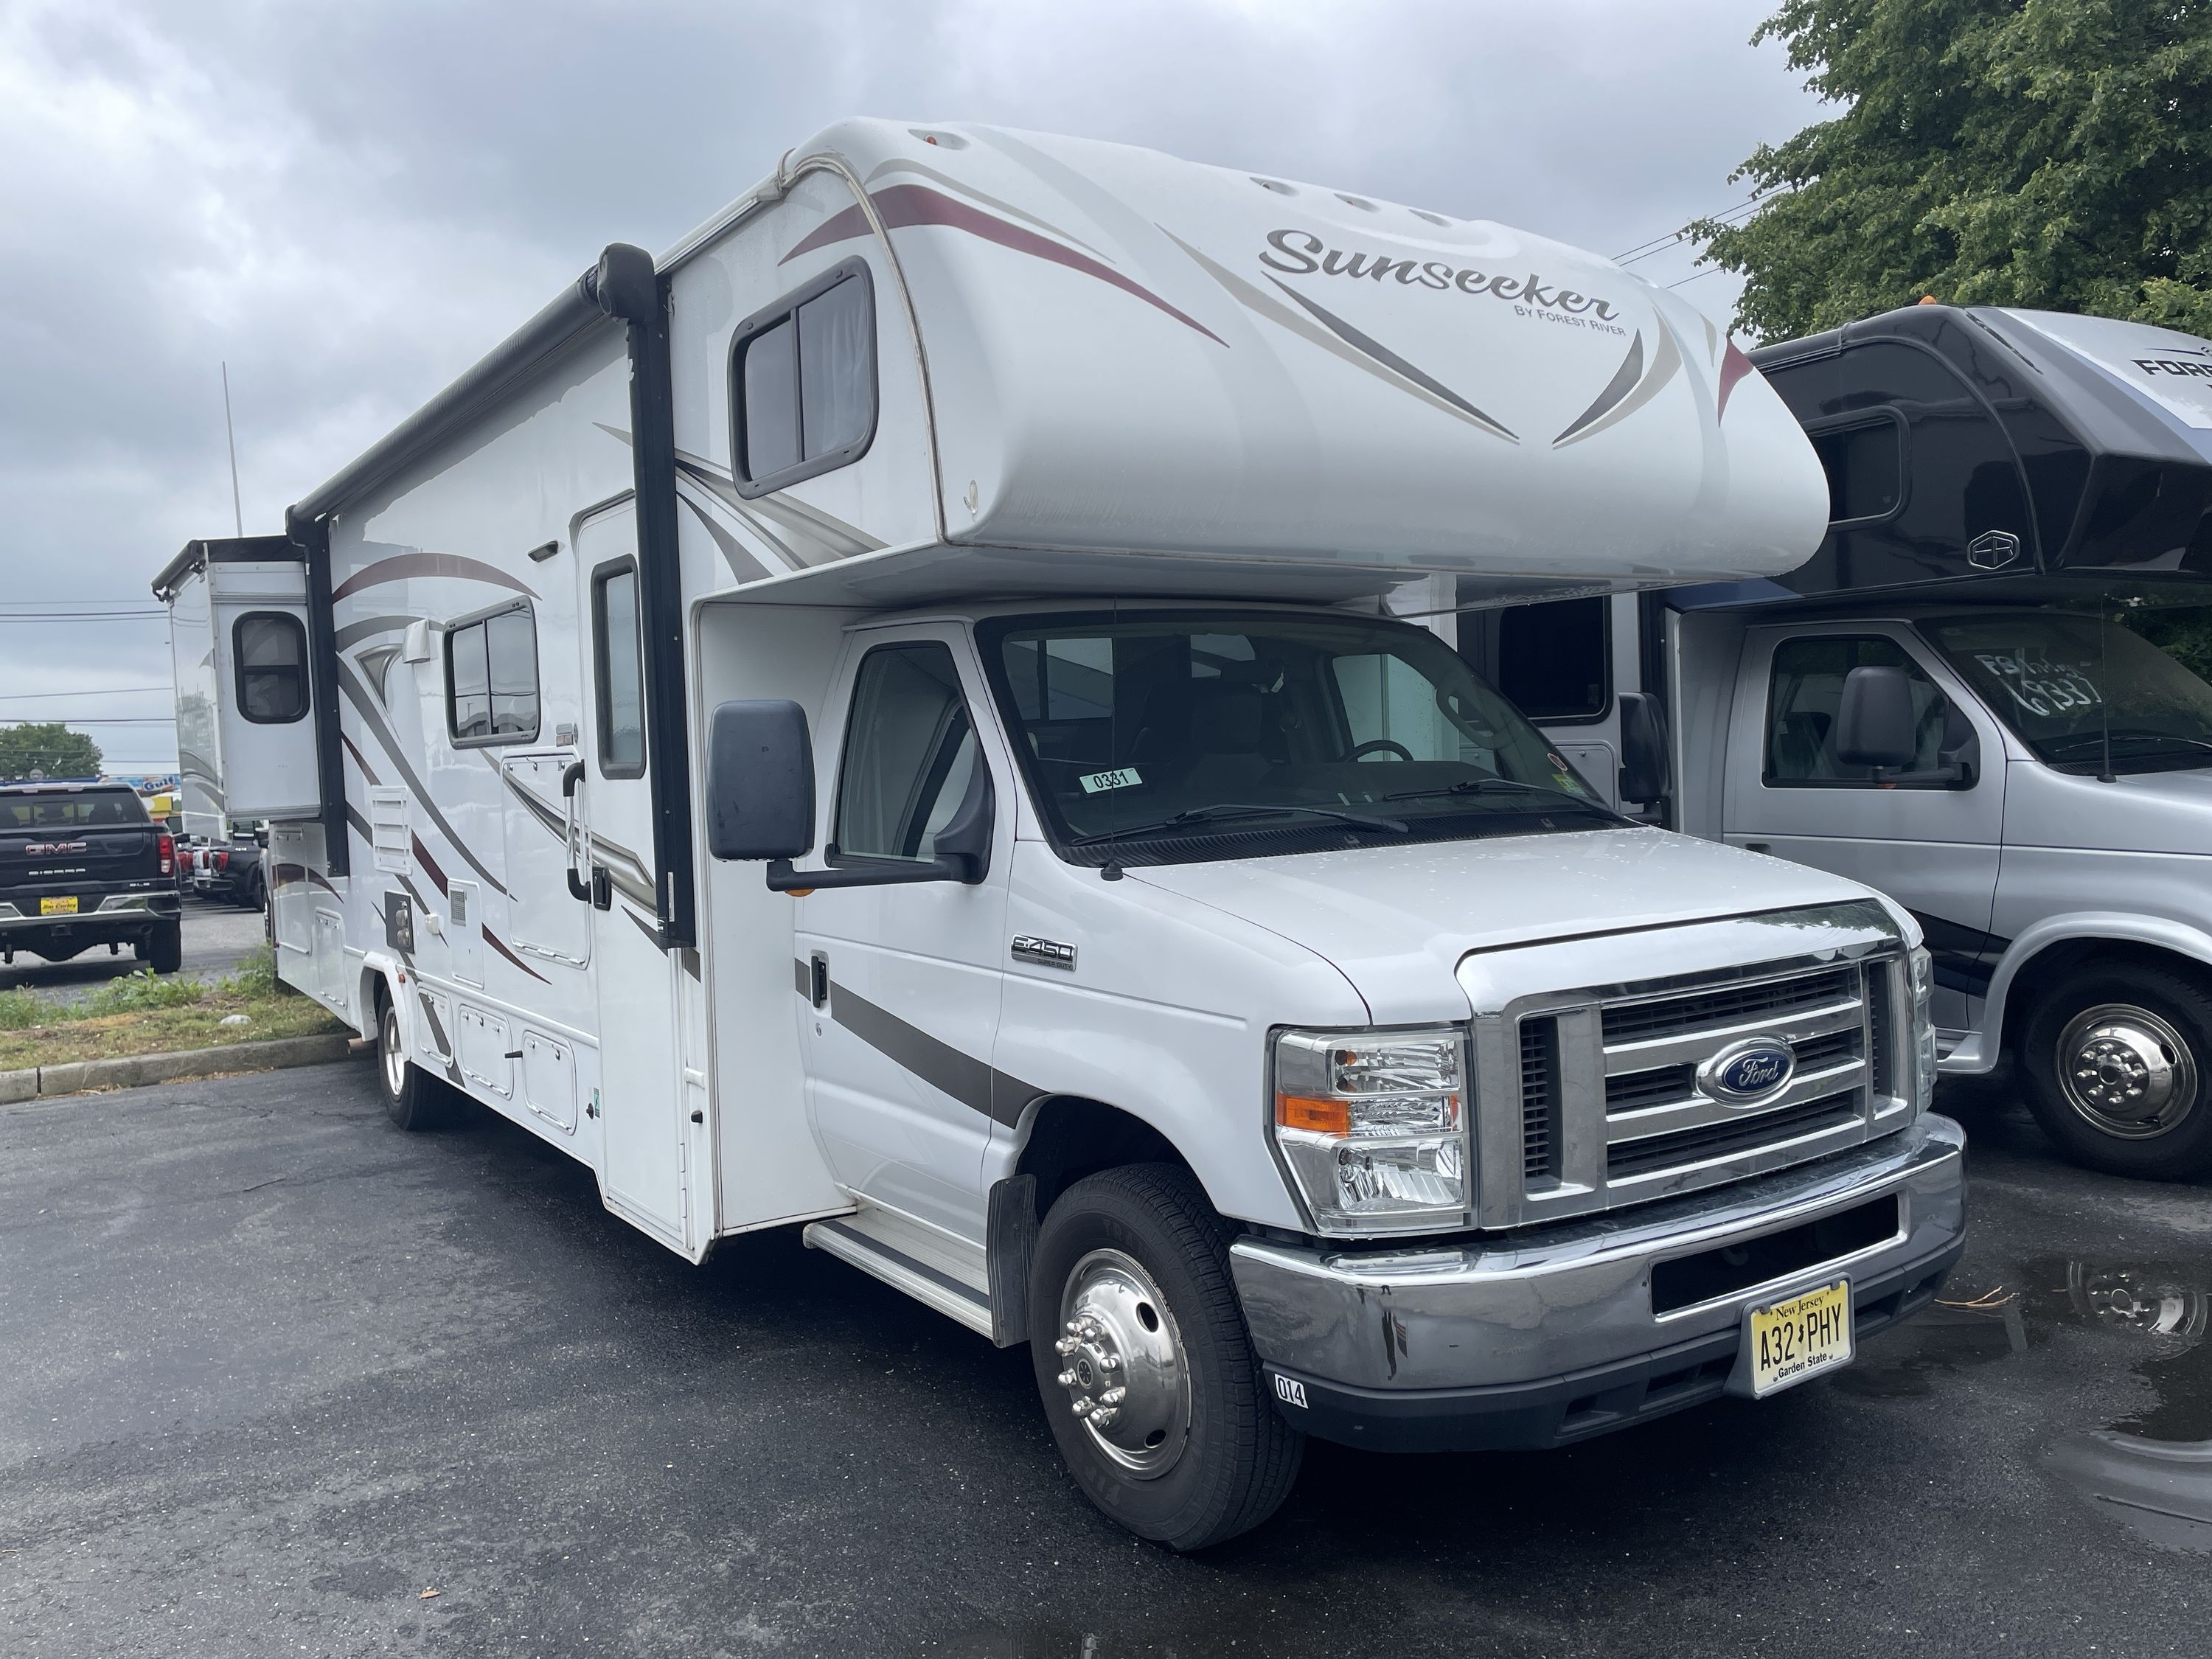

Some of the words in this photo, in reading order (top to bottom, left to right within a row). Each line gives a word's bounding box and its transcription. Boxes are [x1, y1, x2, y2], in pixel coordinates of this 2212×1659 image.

[1258, 229, 1619, 321] Sunseeker
[1514, 305, 1533, 318] BY
[1537, 309, 1587, 327] FOREST
[1590, 319, 1627, 336] RIVER
[144, 776, 174, 790] Gulf
[25, 841, 87, 856] GMC
[1739, 1057, 1779, 1087] Ford
[1775, 1305, 1796, 1321] New
[1797, 1295, 1824, 1315] Jersey
[1760, 1321, 1795, 1371] A32
[1806, 1303, 1842, 1352] PHY
[1778, 1360, 1806, 1378] Garden
[1807, 1352, 1827, 1367] State
[1277, 1377, 1306, 1406] 014
